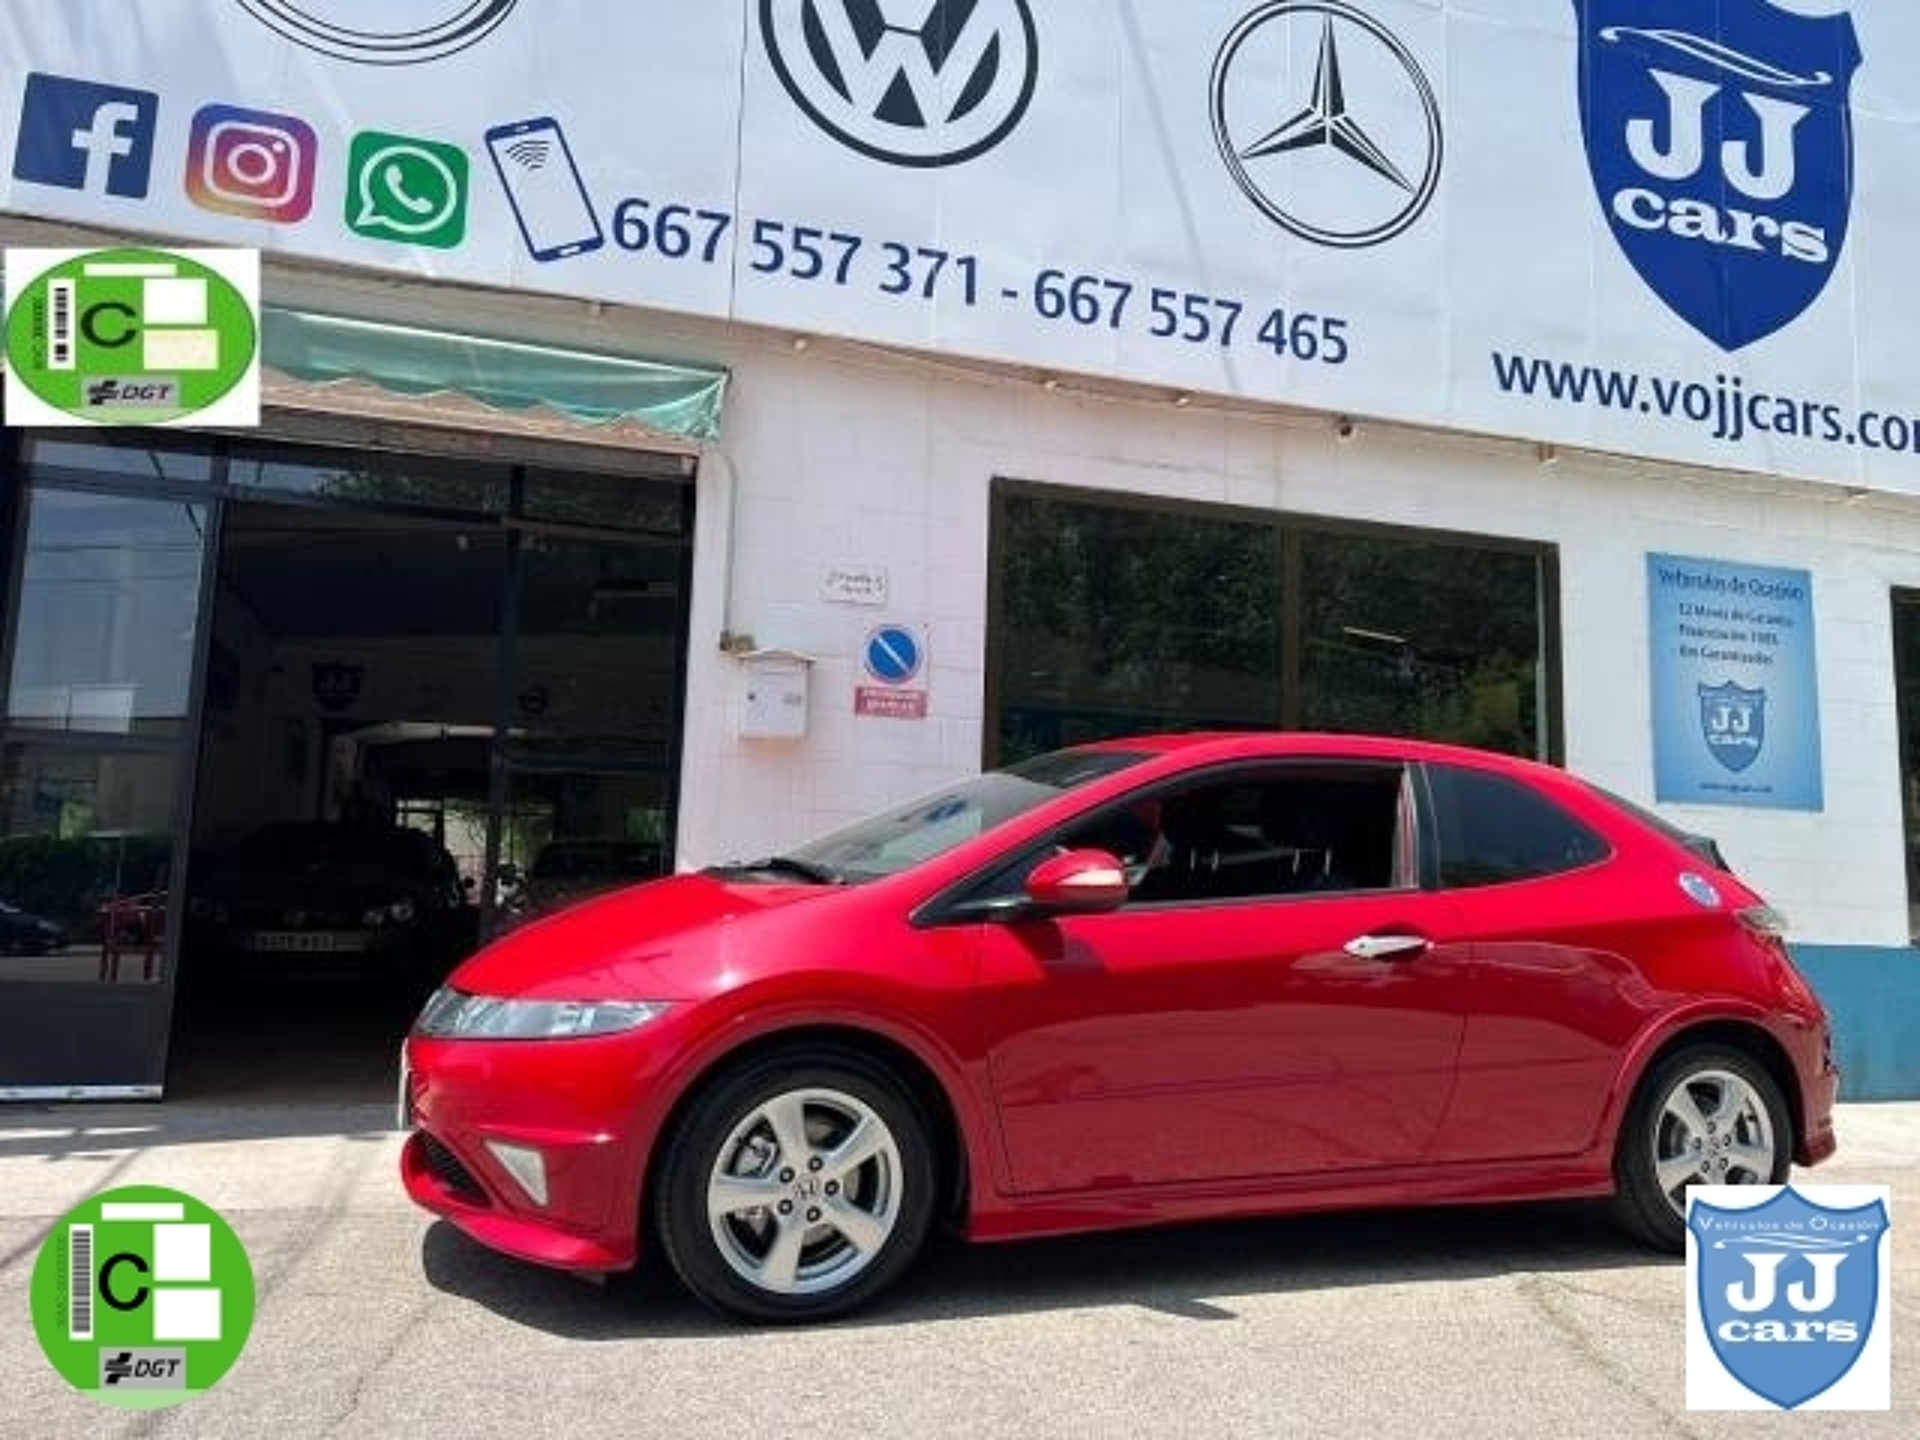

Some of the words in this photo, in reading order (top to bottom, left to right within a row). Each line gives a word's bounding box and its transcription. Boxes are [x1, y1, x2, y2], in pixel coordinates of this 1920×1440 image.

[1625, 68, 1811, 199] JJ
[1613, 188, 1828, 263] cars
[612, 198, 730, 262] 667
[750, 219, 862, 285] 557
[879, 242, 976, 305] 371
[1034, 269, 1132, 329] 667
[1150, 288, 1242, 347] 557
[1256, 307, 1348, 365] 465
[1492, 352, 1920, 453] www.vojjcars.co
[1711, 706, 1753, 733] JJ
